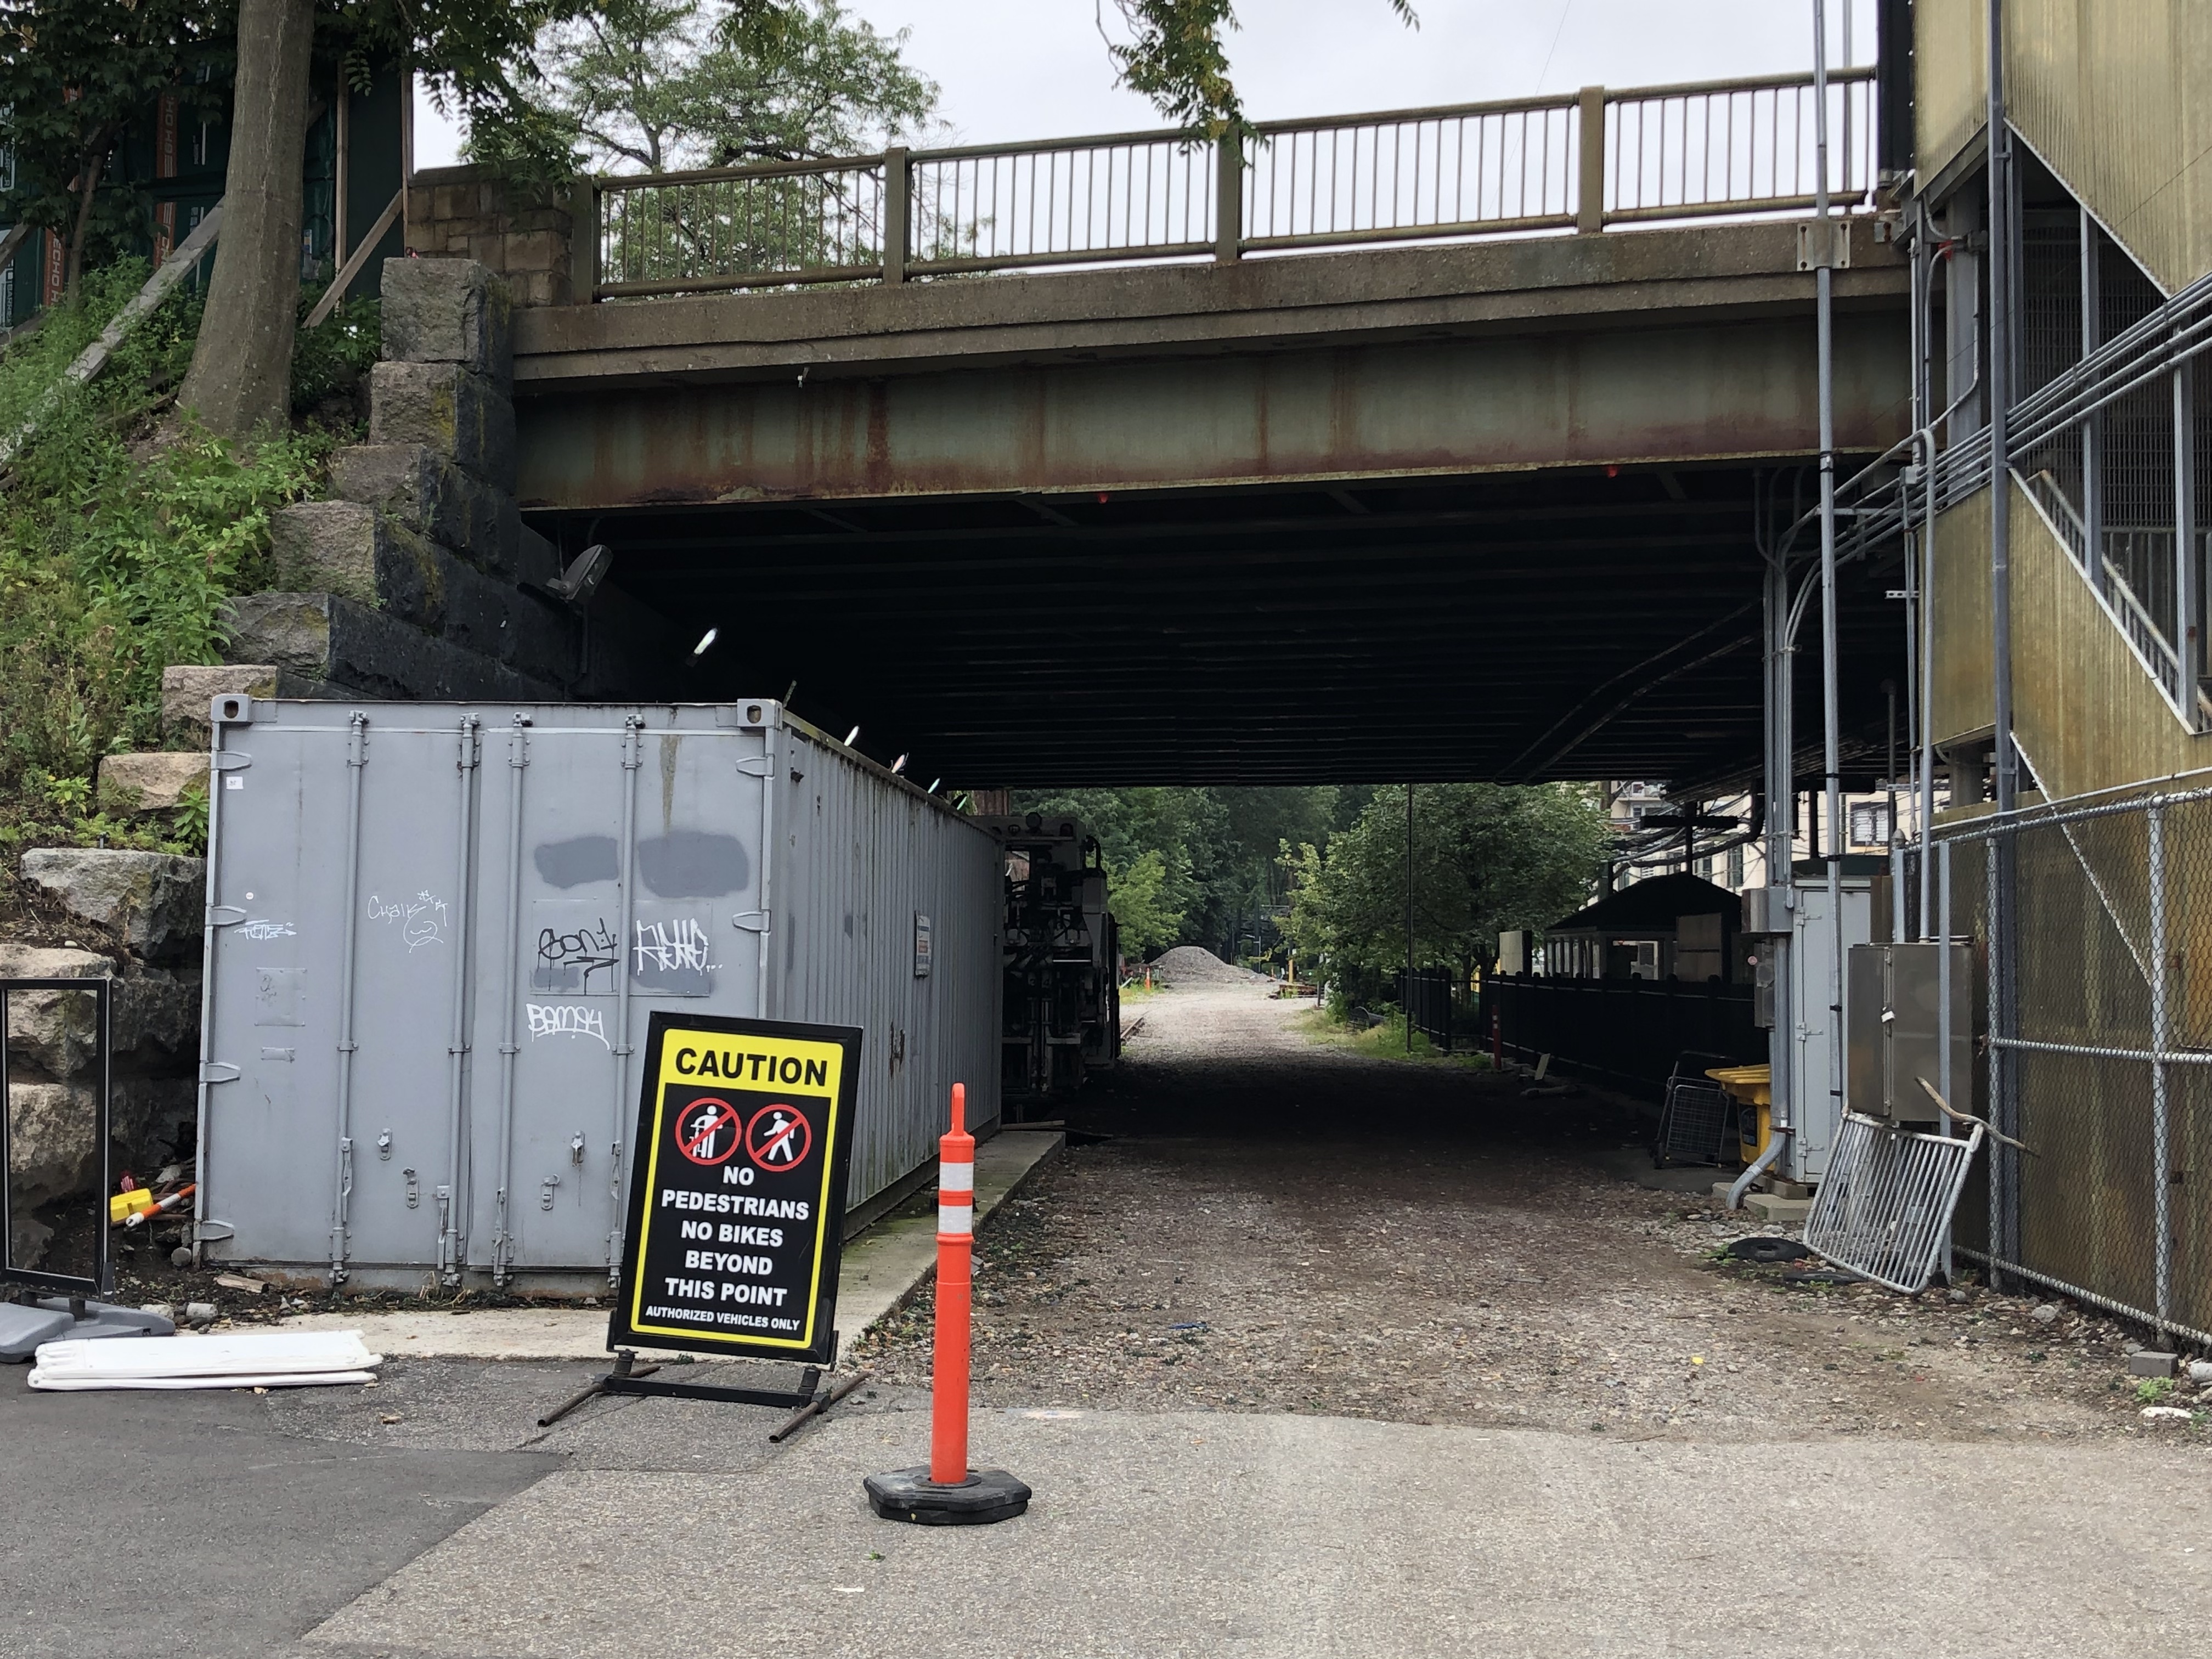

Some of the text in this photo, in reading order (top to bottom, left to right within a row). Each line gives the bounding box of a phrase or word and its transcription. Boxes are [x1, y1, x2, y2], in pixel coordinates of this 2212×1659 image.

[675, 1047, 828, 1087] CAUTION
[723, 1165, 754, 1186] NO
[661, 1189, 809, 1220] PEDESTRIANS
[681, 1220, 783, 1247] NO BIKES
[685, 1250, 772, 1275] BEYOND
[665, 1277, 788, 1306] THIS POINT
[645, 1306, 800, 1331] AUTHORIZED VEHICLES ONLY
